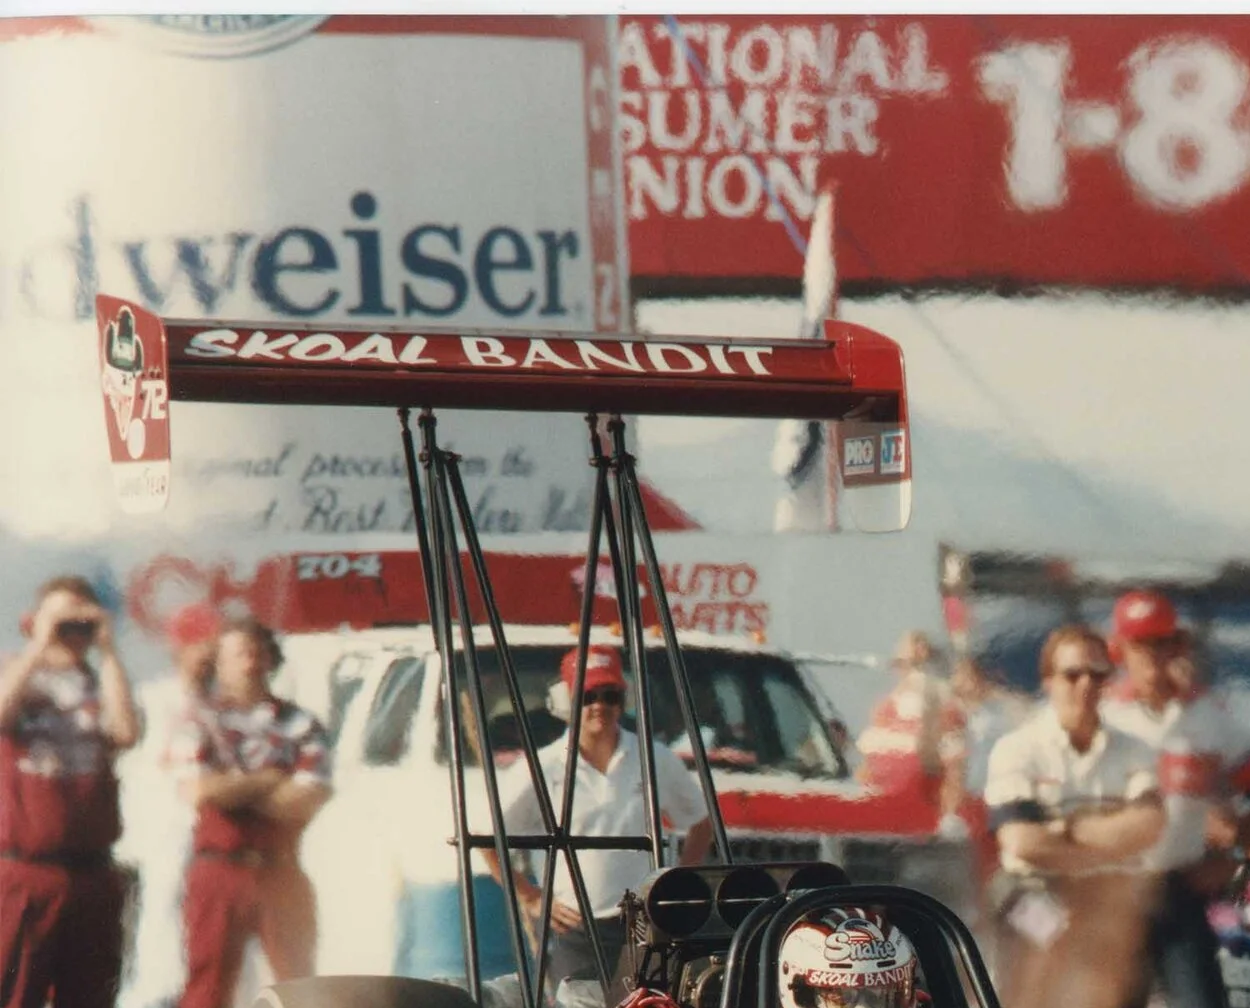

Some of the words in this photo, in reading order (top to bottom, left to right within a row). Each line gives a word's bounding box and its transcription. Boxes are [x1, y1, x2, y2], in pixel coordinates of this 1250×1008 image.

[617, 21, 949, 94] ATIONAL
[617, 89, 880, 155] SUMER
[626, 154, 820, 221] NION
[20, 190, 579, 319] dweiser
[184, 328, 437, 366] SKOAL
[461, 335, 774, 376] BANDIT
[808, 971, 861, 987] SKOAL
[824, 931, 896, 961] Snake
